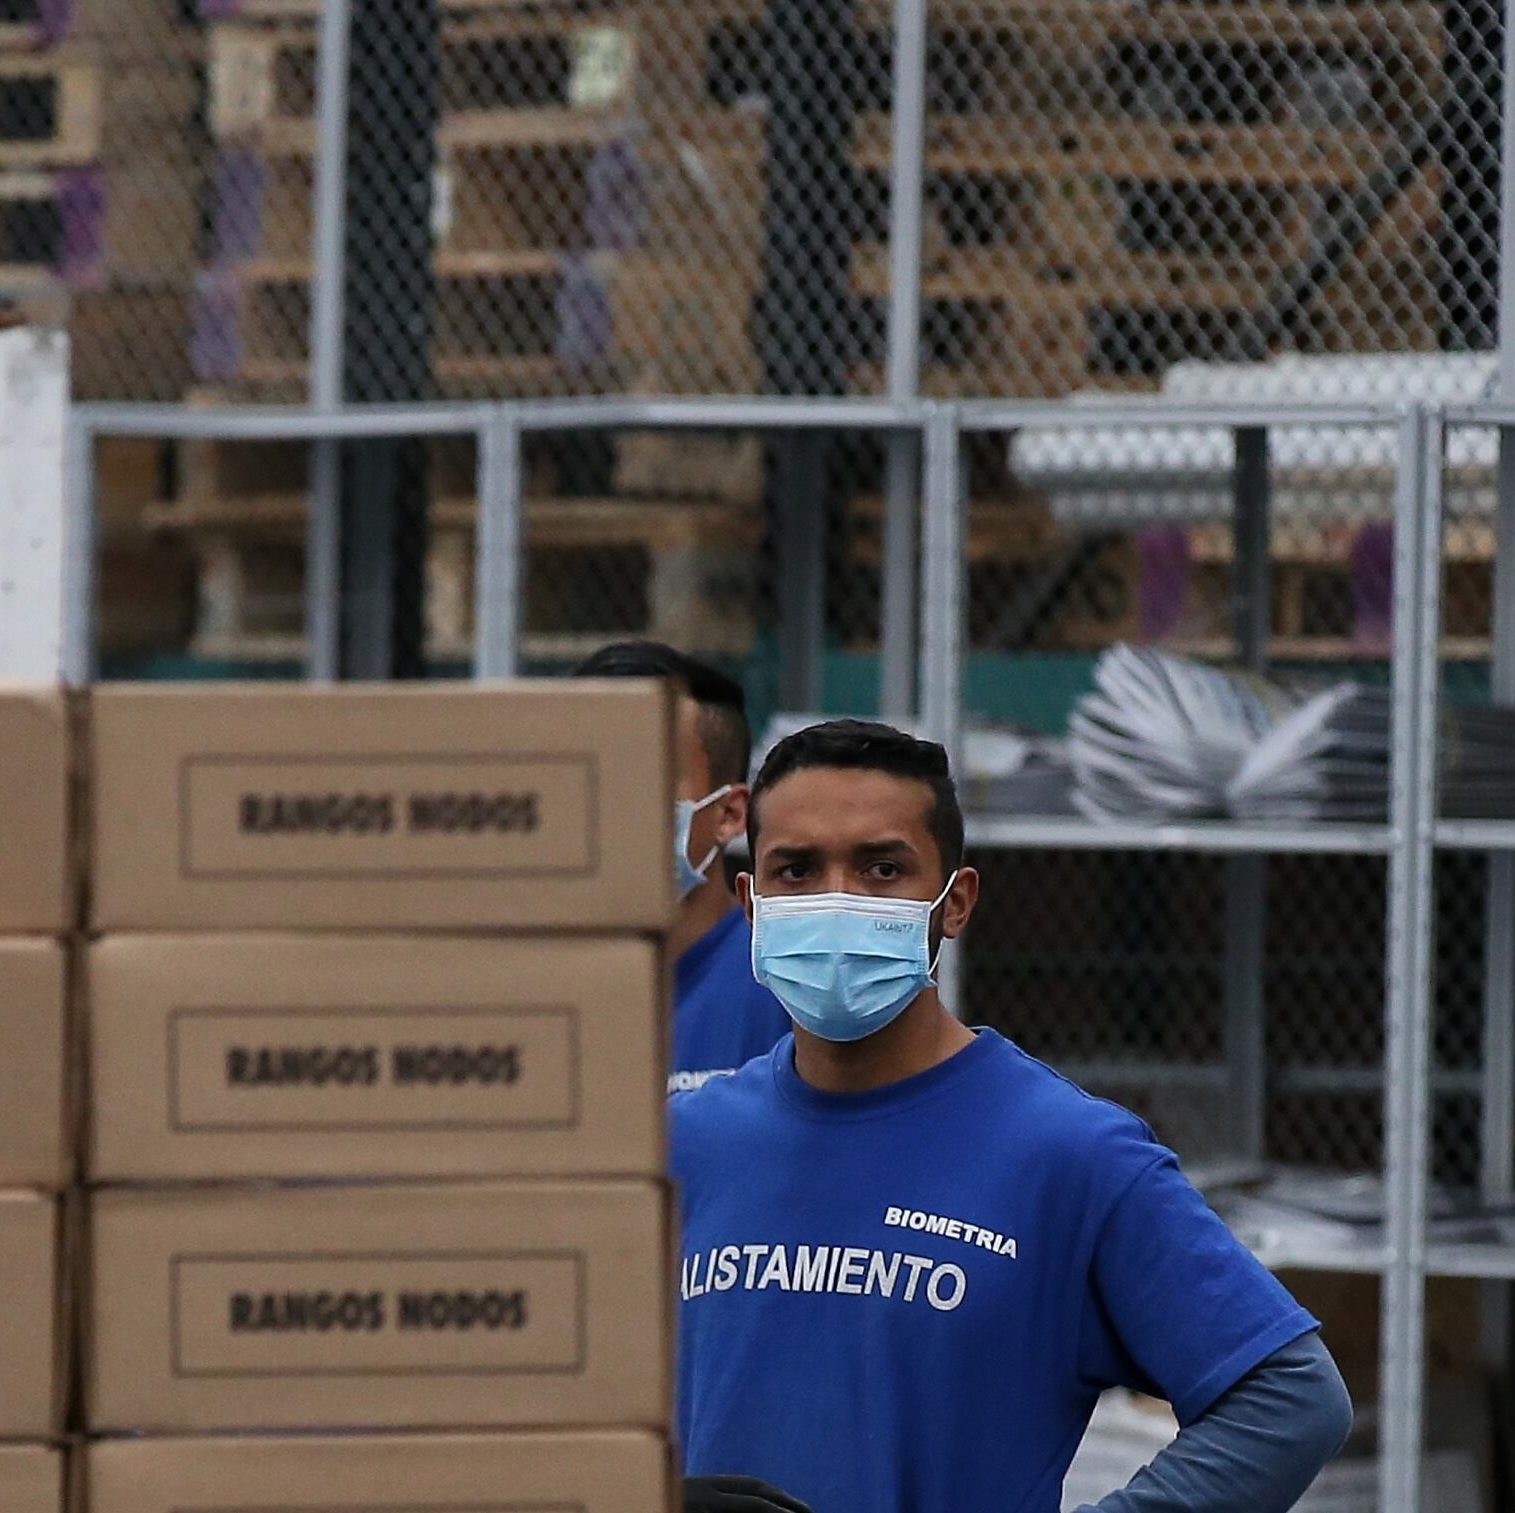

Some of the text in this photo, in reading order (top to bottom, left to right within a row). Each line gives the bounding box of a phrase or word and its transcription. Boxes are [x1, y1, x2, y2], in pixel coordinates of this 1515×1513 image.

[238, 791, 539, 836] RANGOS NODOS
[225, 1044, 522, 1088] RANGOS NODOS
[884, 1206, 1018, 1259] BIOMETRIA
[230, 1290, 527, 1332] RANGOS NODOS
